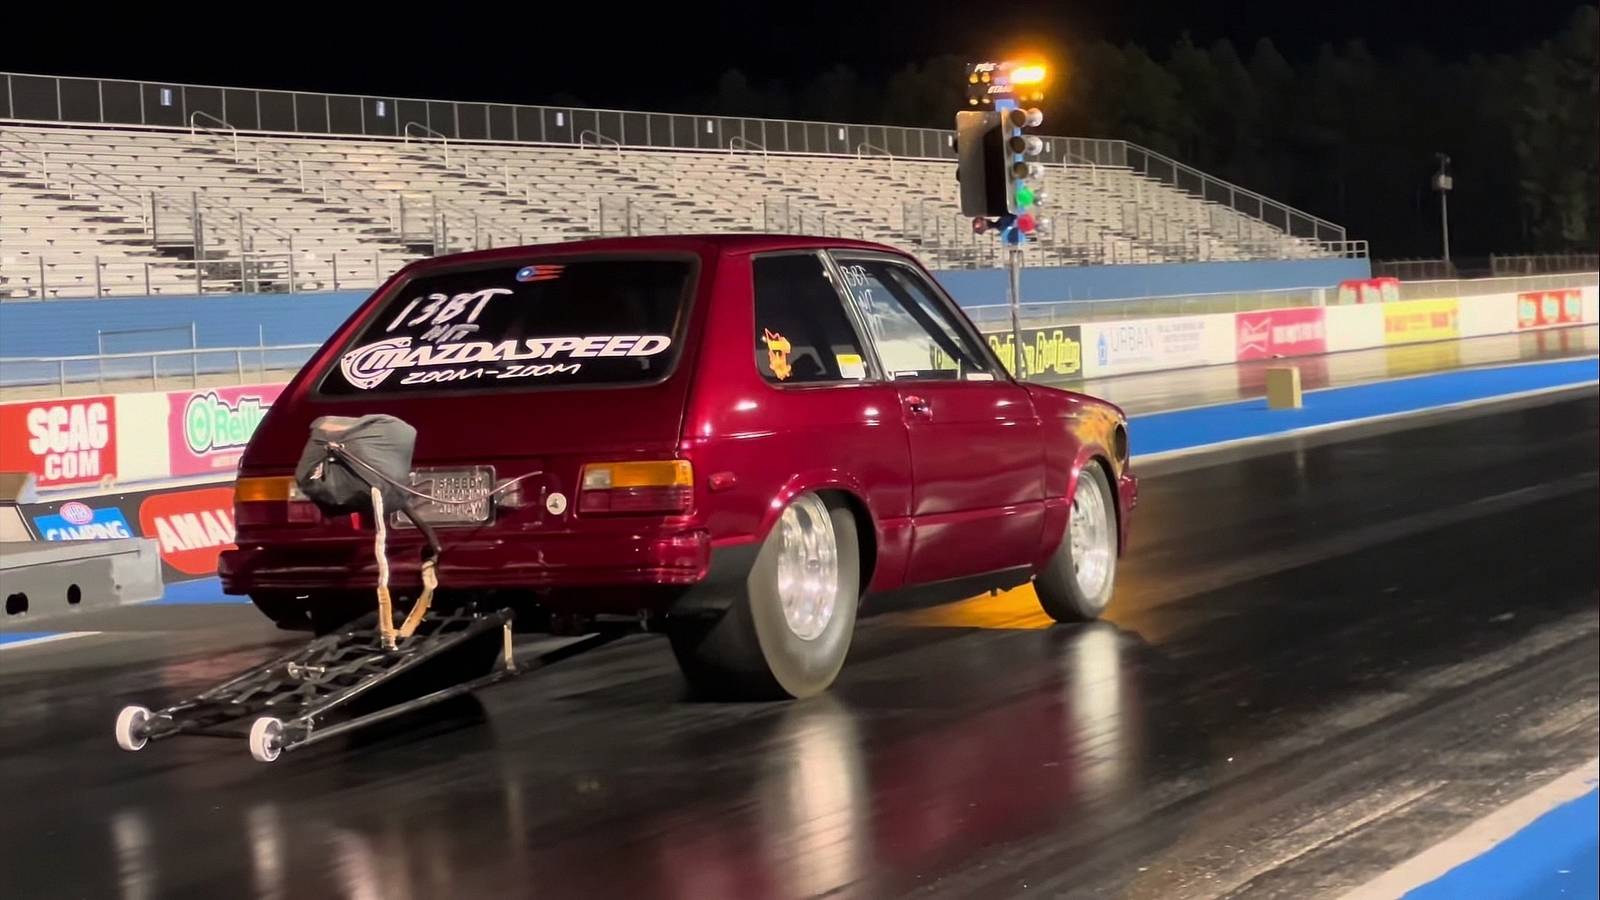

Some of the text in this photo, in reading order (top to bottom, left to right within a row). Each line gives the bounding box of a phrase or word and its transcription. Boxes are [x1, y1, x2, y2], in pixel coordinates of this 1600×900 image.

[385, 288, 514, 332] 13BT
[359, 335, 672, 371] MAZDASPEED
[400, 362, 582, 385] ZOOM-ZOOM
[26, 402, 108, 456] SCAG
[186, 391, 269, 453] O'Reill
[39, 450, 100, 481] .COM
[154, 509, 236, 554] AMAL
